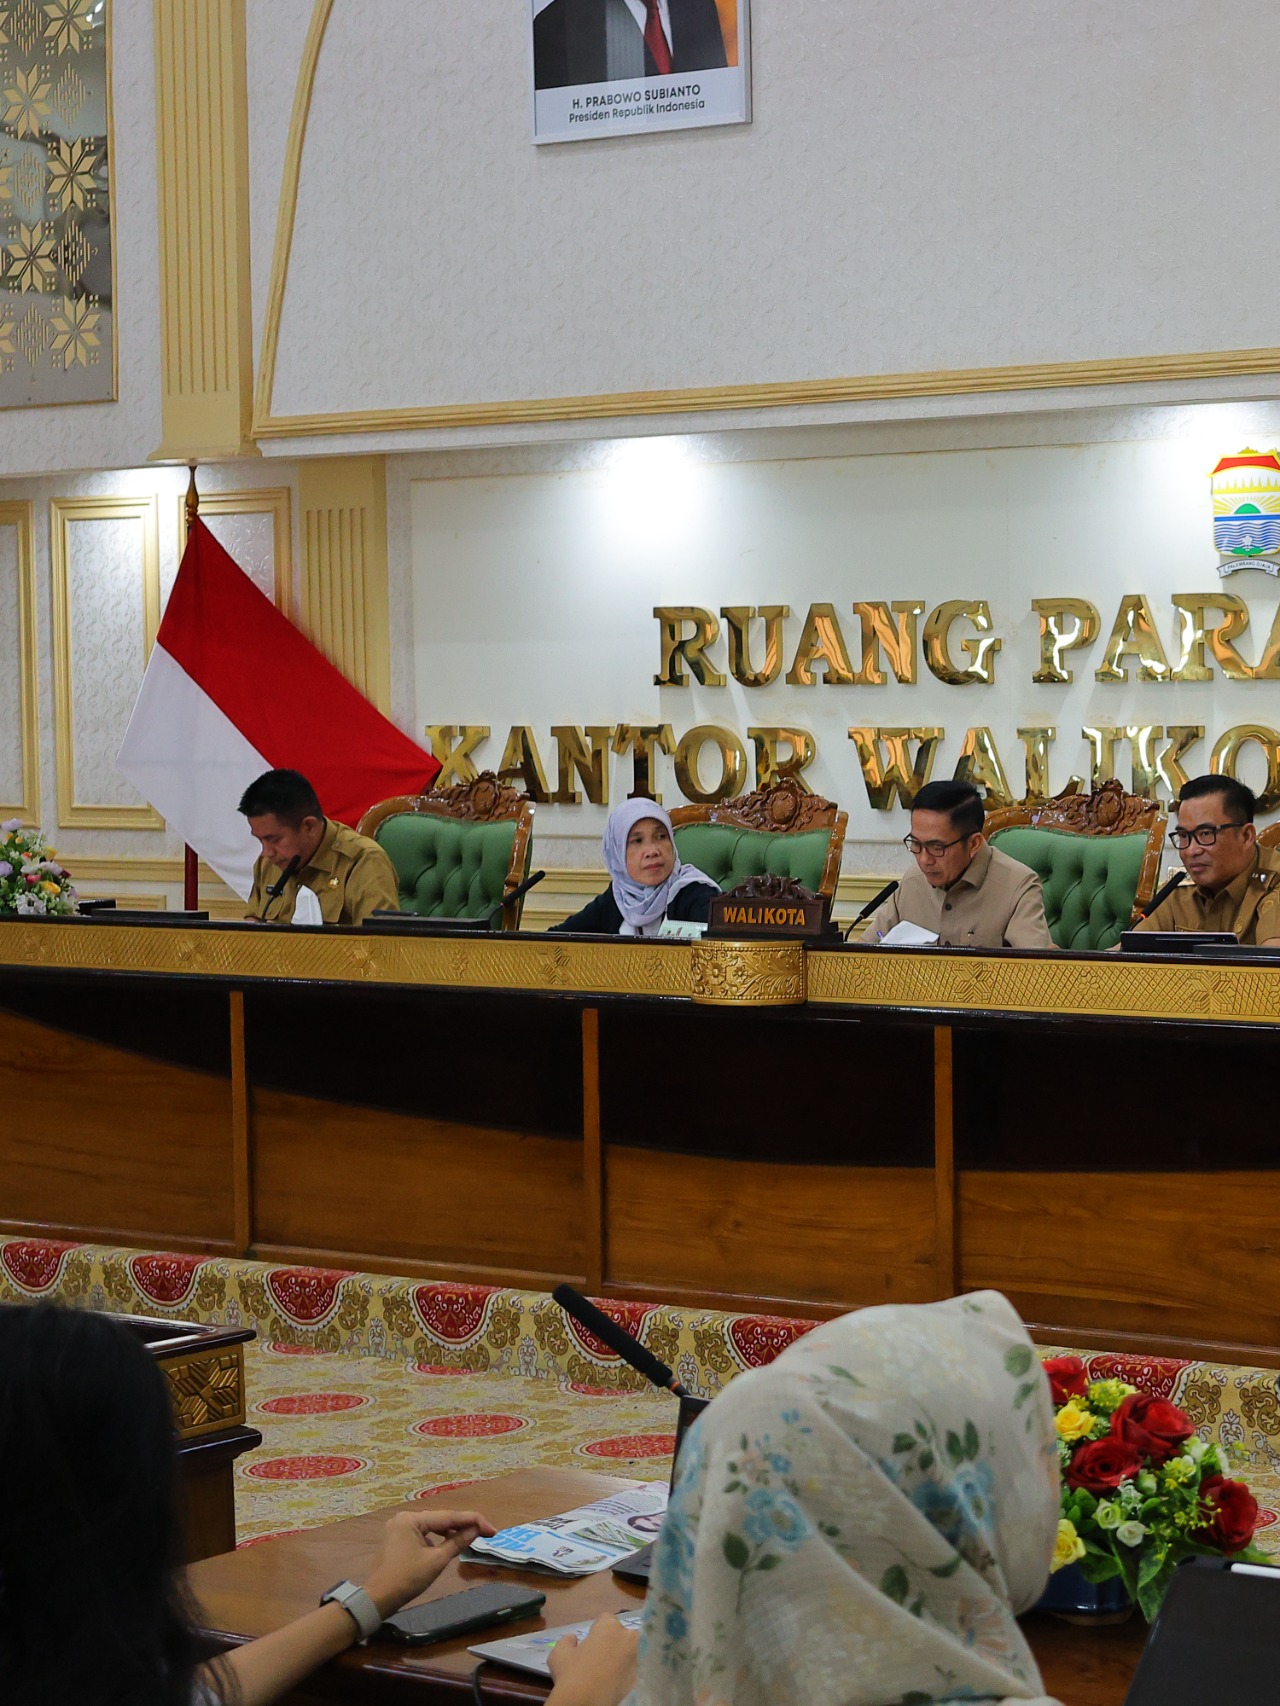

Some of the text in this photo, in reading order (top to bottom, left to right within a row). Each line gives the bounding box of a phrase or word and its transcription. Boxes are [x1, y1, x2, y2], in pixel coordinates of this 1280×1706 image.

[572, 84, 701, 110] H. PRABOWO SUBIANTO
[569, 98, 705, 124] Presiden Republik Indonesia
[652, 599, 1002, 688] RUANG
[424, 722, 819, 805] KANTOR
[723, 906, 806, 927] WALIKOTA
